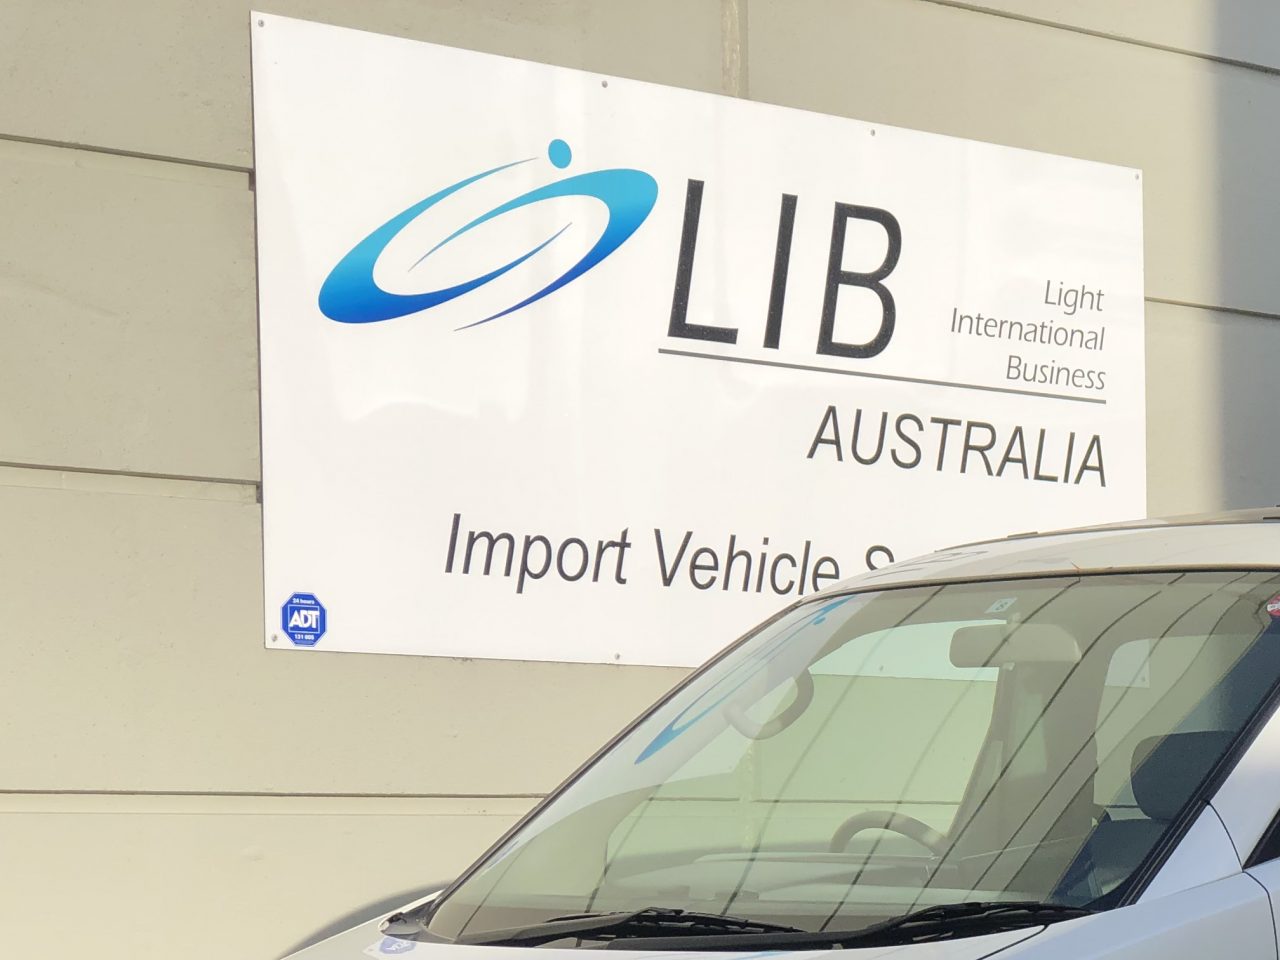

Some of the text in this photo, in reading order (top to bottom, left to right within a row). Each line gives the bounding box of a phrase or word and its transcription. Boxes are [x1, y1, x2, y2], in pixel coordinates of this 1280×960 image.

[667, 178, 902, 359] LIB
[1044, 279, 1105, 316] Light
[951, 307, 1105, 351] International
[1006, 354, 1106, 390] Business
[806, 405, 1107, 487] AUSTRALIA
[444, 513, 840, 596] Import Vehicle
[288, 609, 320, 629] ADT
